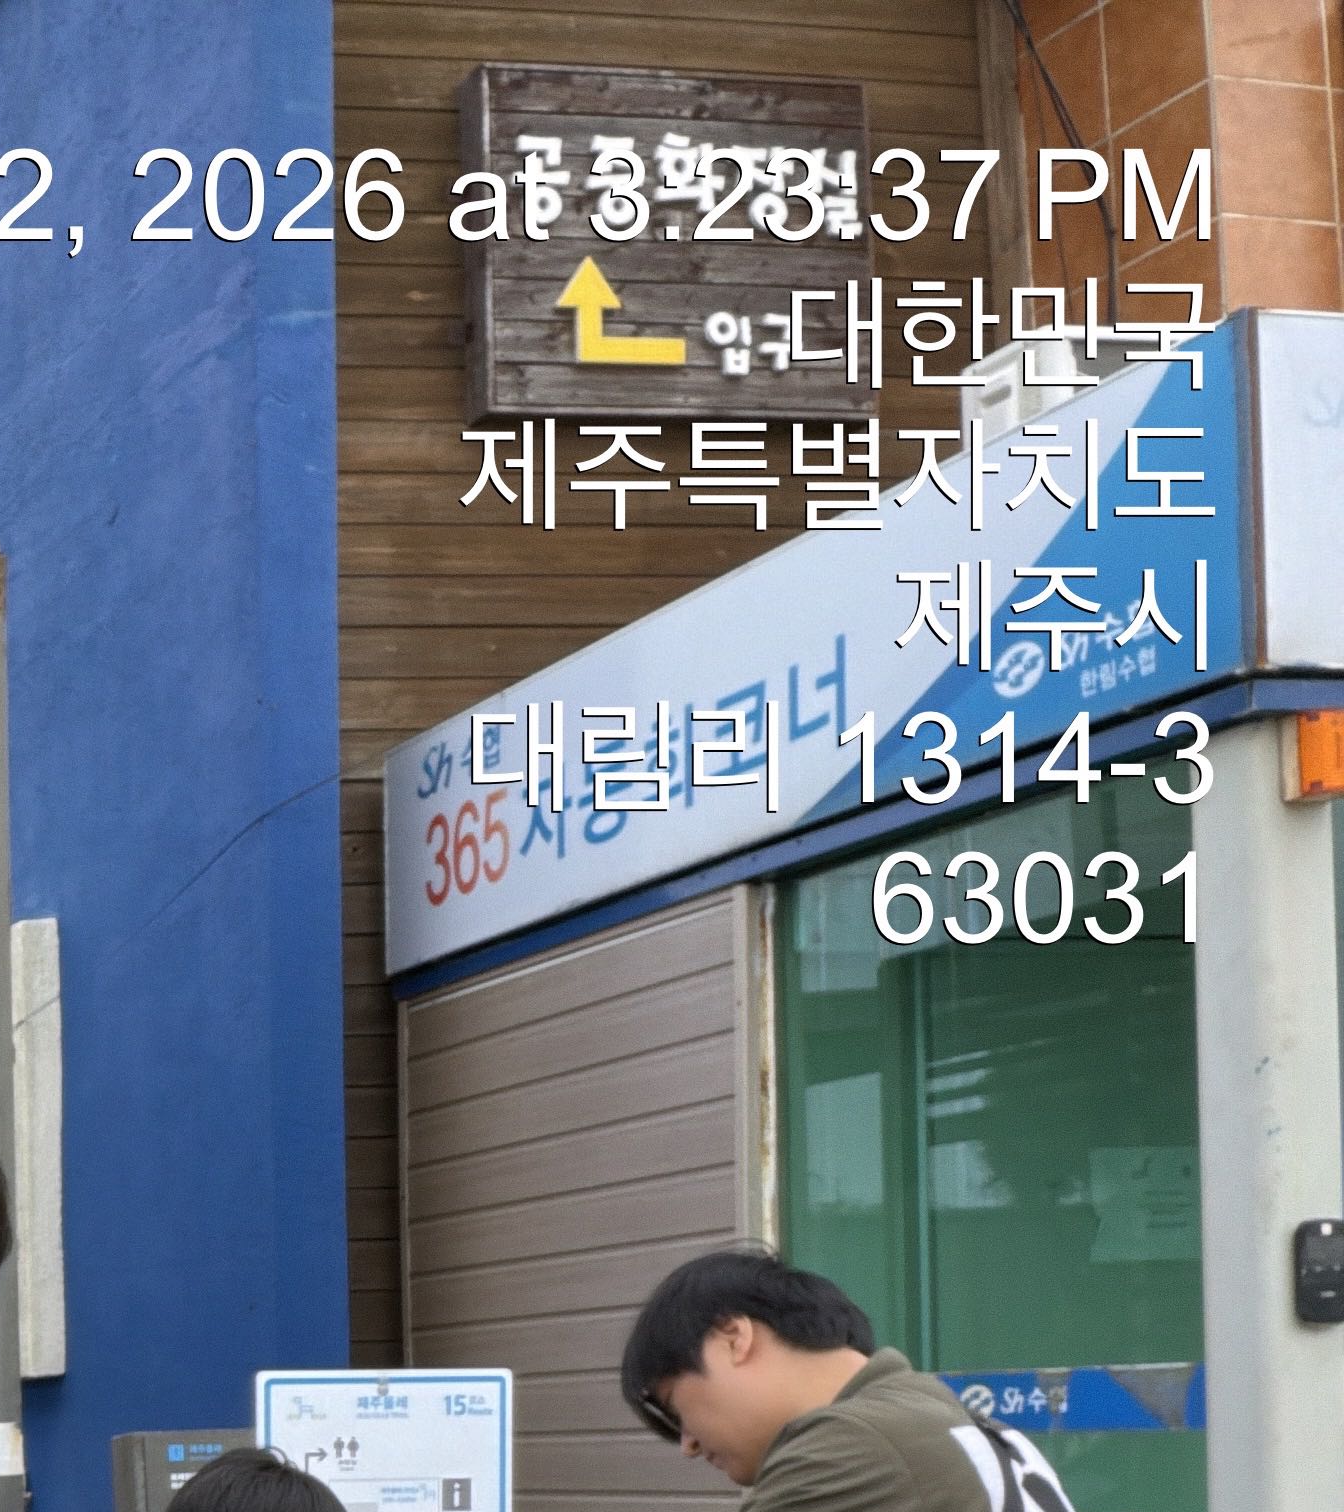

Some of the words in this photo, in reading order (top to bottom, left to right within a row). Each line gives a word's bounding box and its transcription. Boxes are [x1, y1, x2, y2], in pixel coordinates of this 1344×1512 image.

[1079, 645, 1157, 699] 한림수협
[424, 788, 512, 908] 365
[443, 1393, 467, 1416] 15
